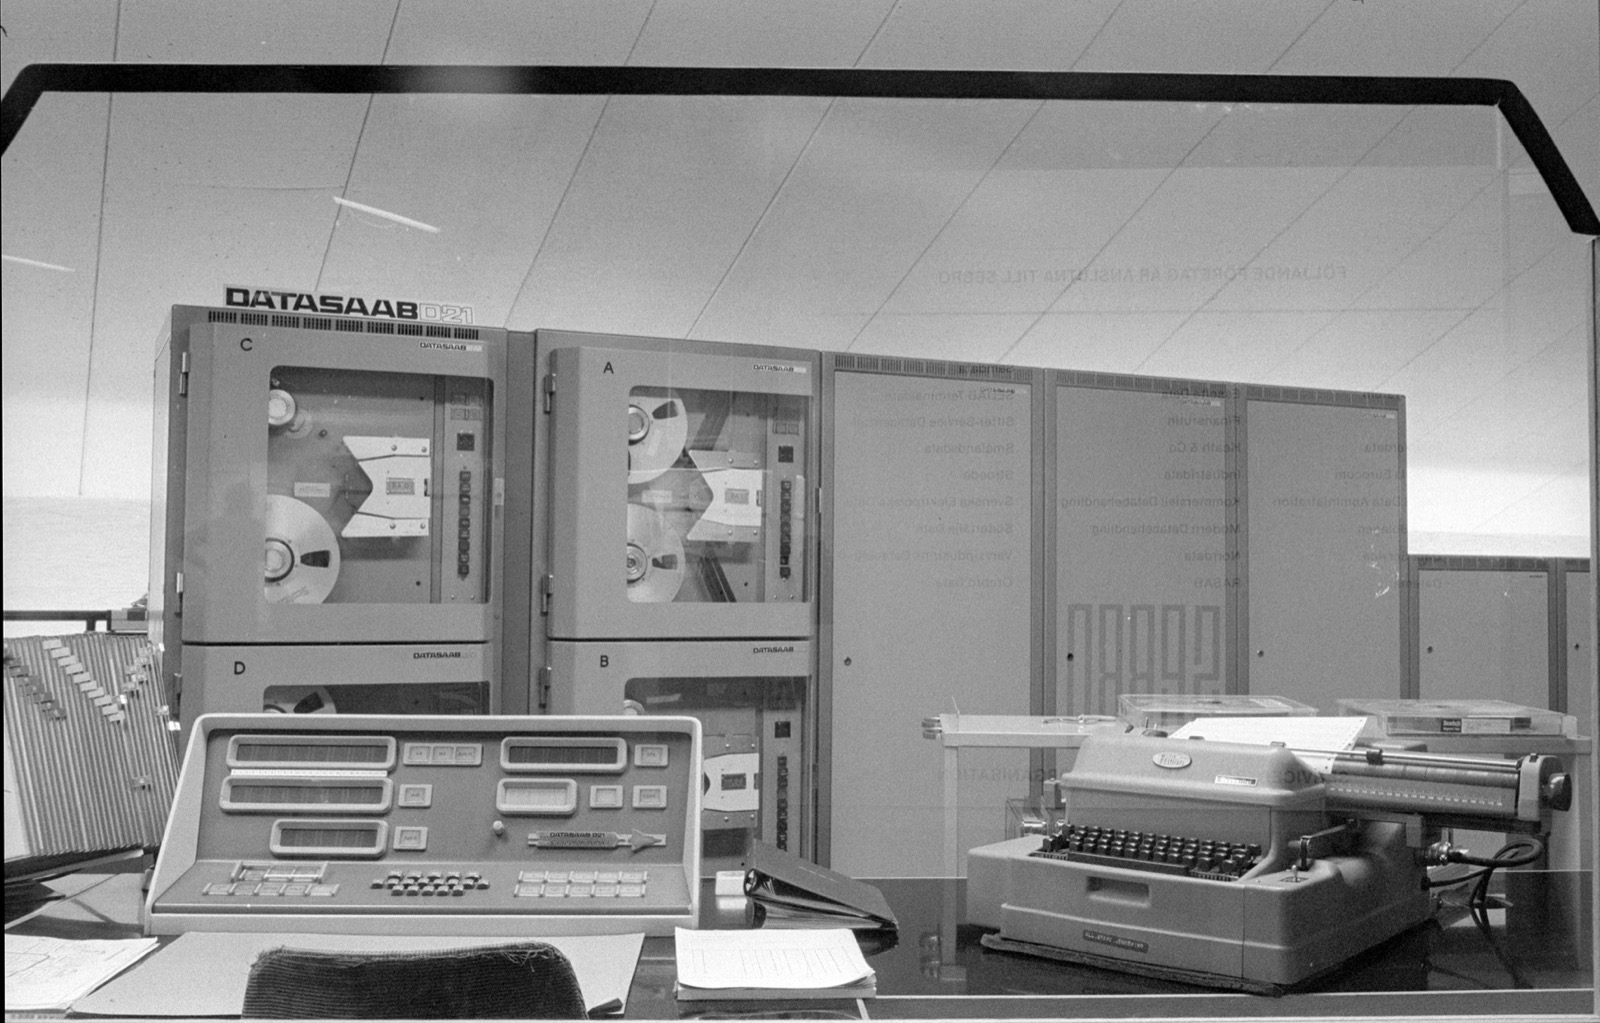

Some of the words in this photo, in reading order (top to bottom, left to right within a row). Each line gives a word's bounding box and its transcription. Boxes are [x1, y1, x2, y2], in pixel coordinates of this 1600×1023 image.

[225, 287, 419, 320] DATASAAB
[419, 303, 474, 324] D21
[240, 338, 253, 351] C
[420, 342, 467, 351] DATASAAB
[603, 361, 614, 375] A
[753, 364, 794, 372] DATASAAB
[234, 661, 246, 675] D
[600, 655, 609, 668] B
